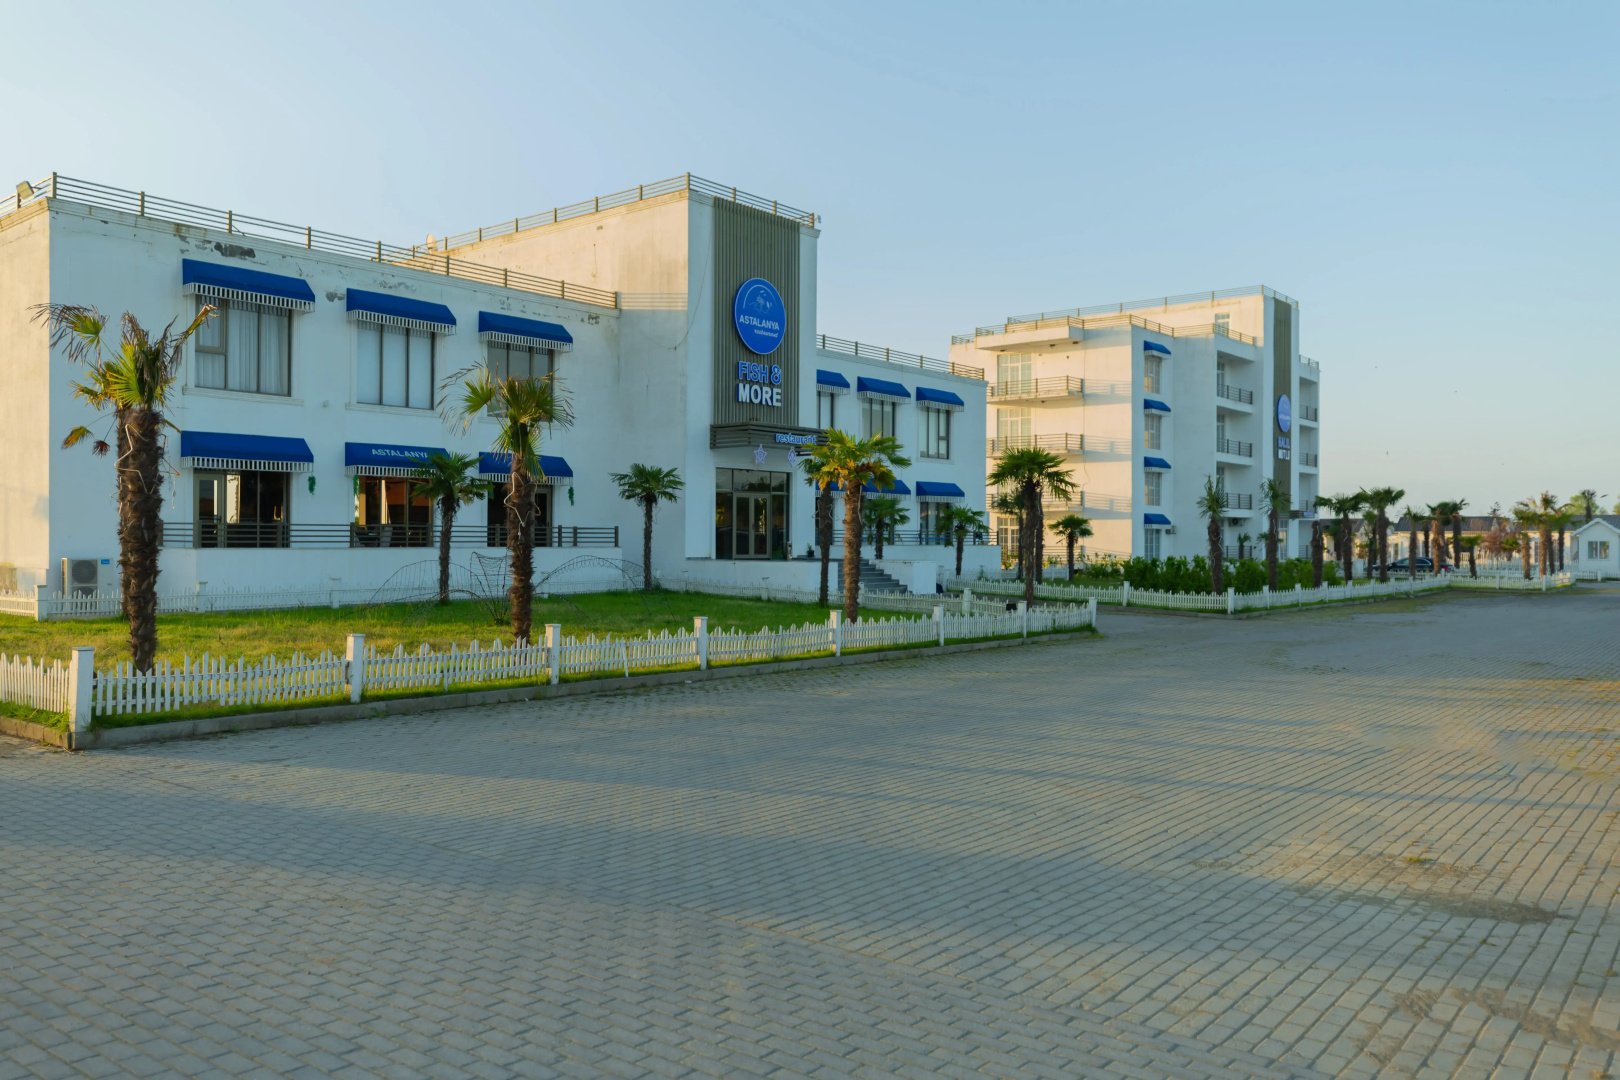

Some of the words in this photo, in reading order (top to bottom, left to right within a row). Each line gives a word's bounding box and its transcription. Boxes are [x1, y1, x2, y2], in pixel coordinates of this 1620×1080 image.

[739, 314, 779, 330] ASTALANYA
[738, 361, 768, 383] FISH
[771, 364, 781, 385] &
[738, 383, 781, 406] MORE
[775, 432, 816, 445] restaurant
